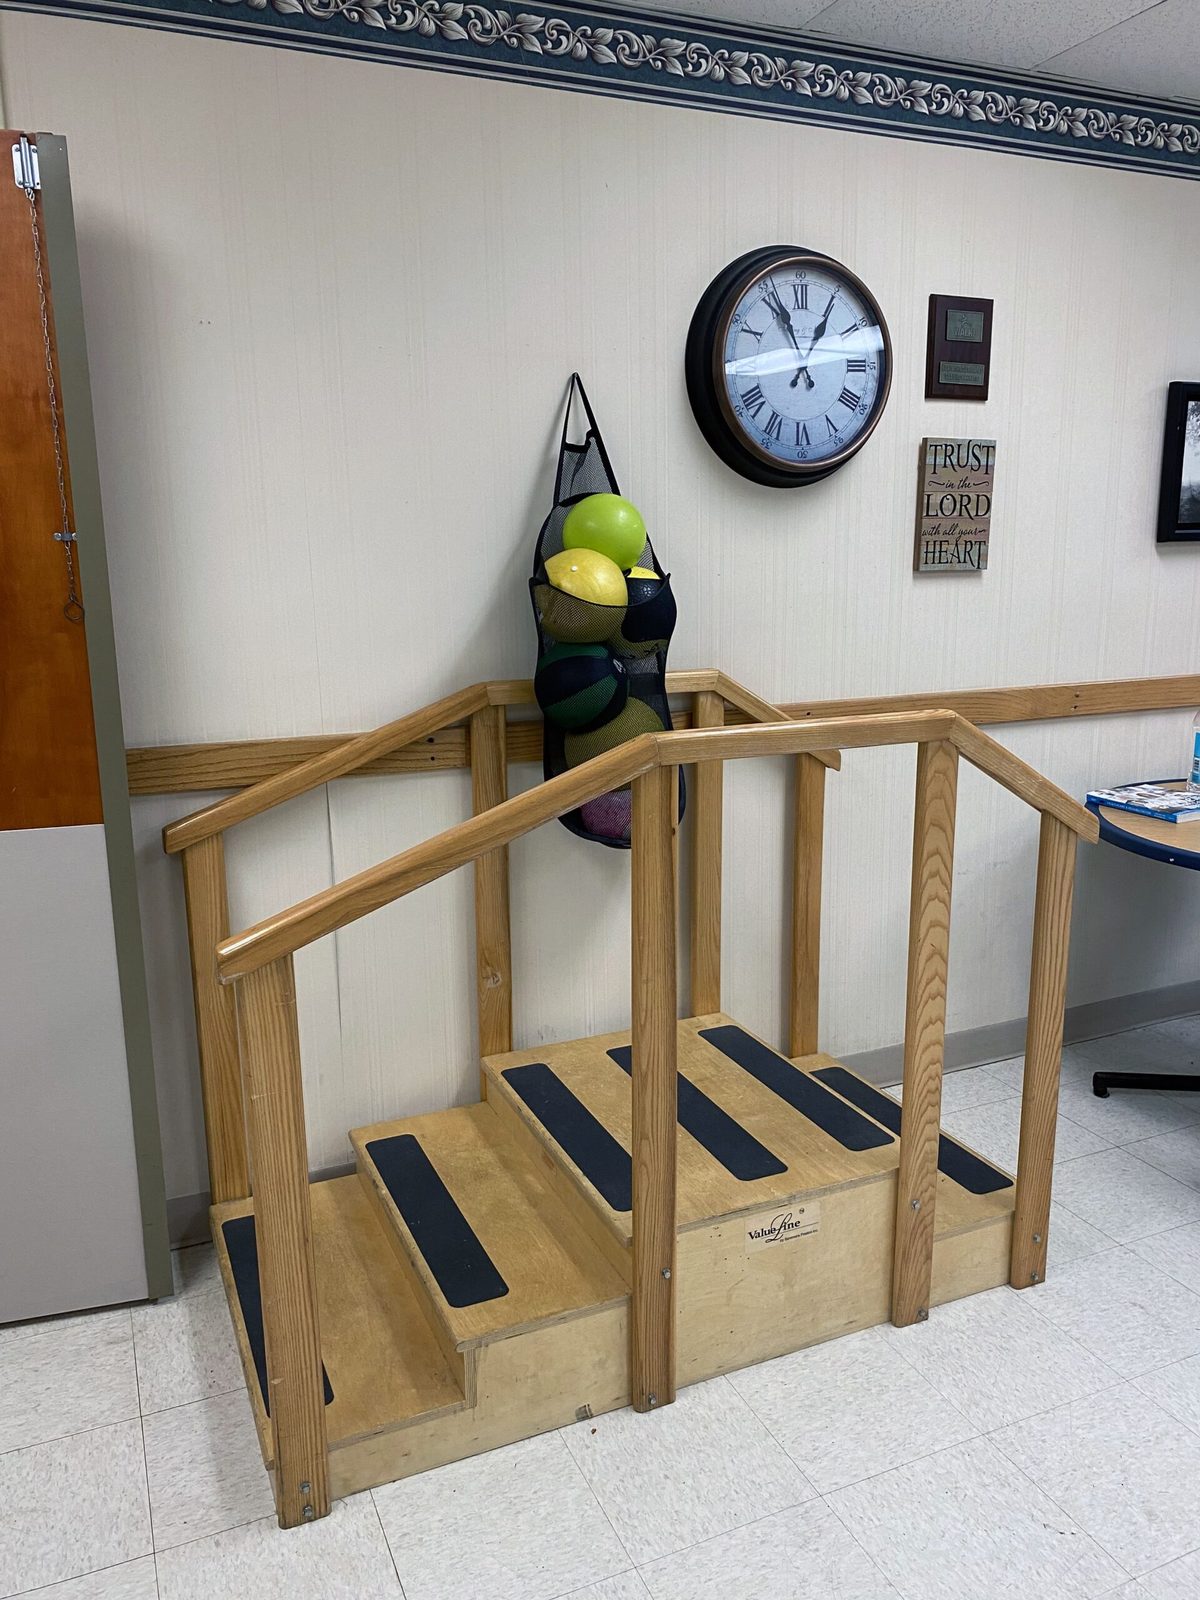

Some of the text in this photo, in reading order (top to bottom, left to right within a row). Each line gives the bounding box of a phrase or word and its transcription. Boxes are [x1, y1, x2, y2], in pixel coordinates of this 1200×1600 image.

[795, 270, 807, 279] 60
[758, 280, 769, 293] 55
[791, 283, 809, 310] XII
[859, 316, 868, 327] 10
[846, 358, 867, 374] III
[869, 361, 876, 371] 15
[762, 410, 783, 442] VII
[795, 421, 812, 446] VI
[825, 414, 839, 438] V
[797, 450, 808, 459] 30
[928, 440, 995, 475] TRUST
[944, 476, 972, 489] in the
[923, 493, 991, 520] LORD
[922, 523, 980, 541] with all your
[923, 540, 987, 570] HEART
